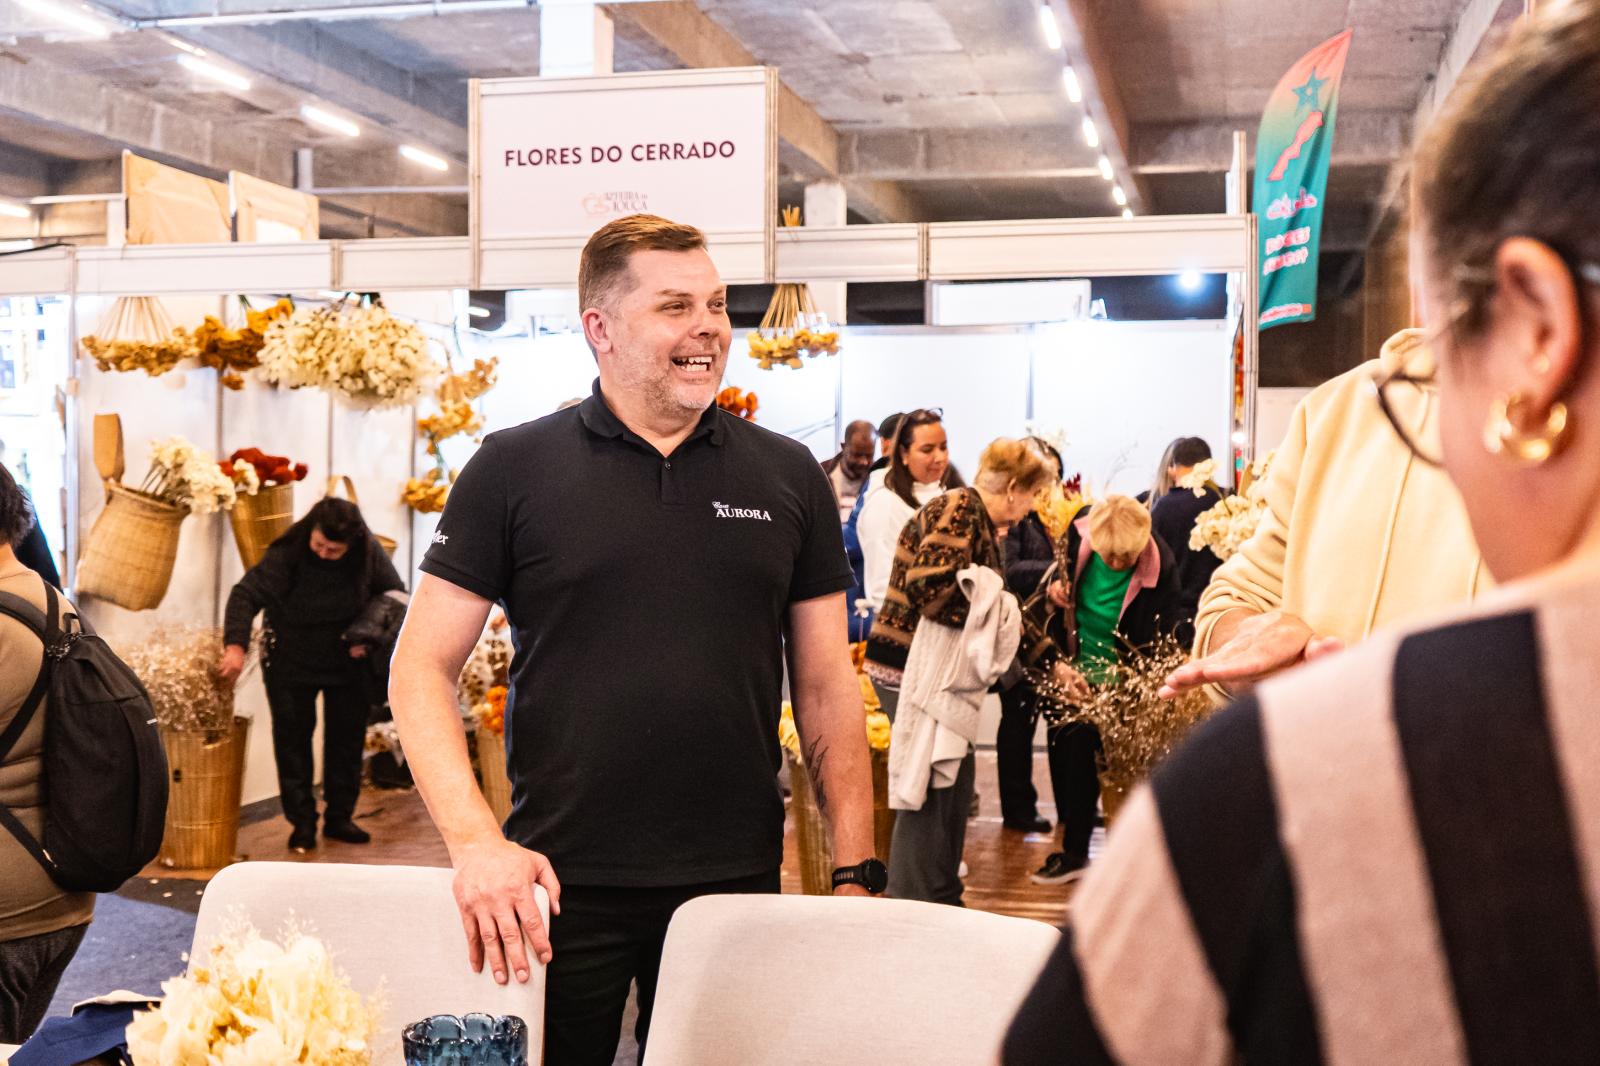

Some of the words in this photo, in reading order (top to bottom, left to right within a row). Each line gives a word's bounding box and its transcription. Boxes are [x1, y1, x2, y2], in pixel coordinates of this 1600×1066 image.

[505, 147, 582, 167] FLORES
[591, 146, 623, 163] DO
[631, 140, 736, 162] CERRADO
[716, 508, 772, 521] AURORA
